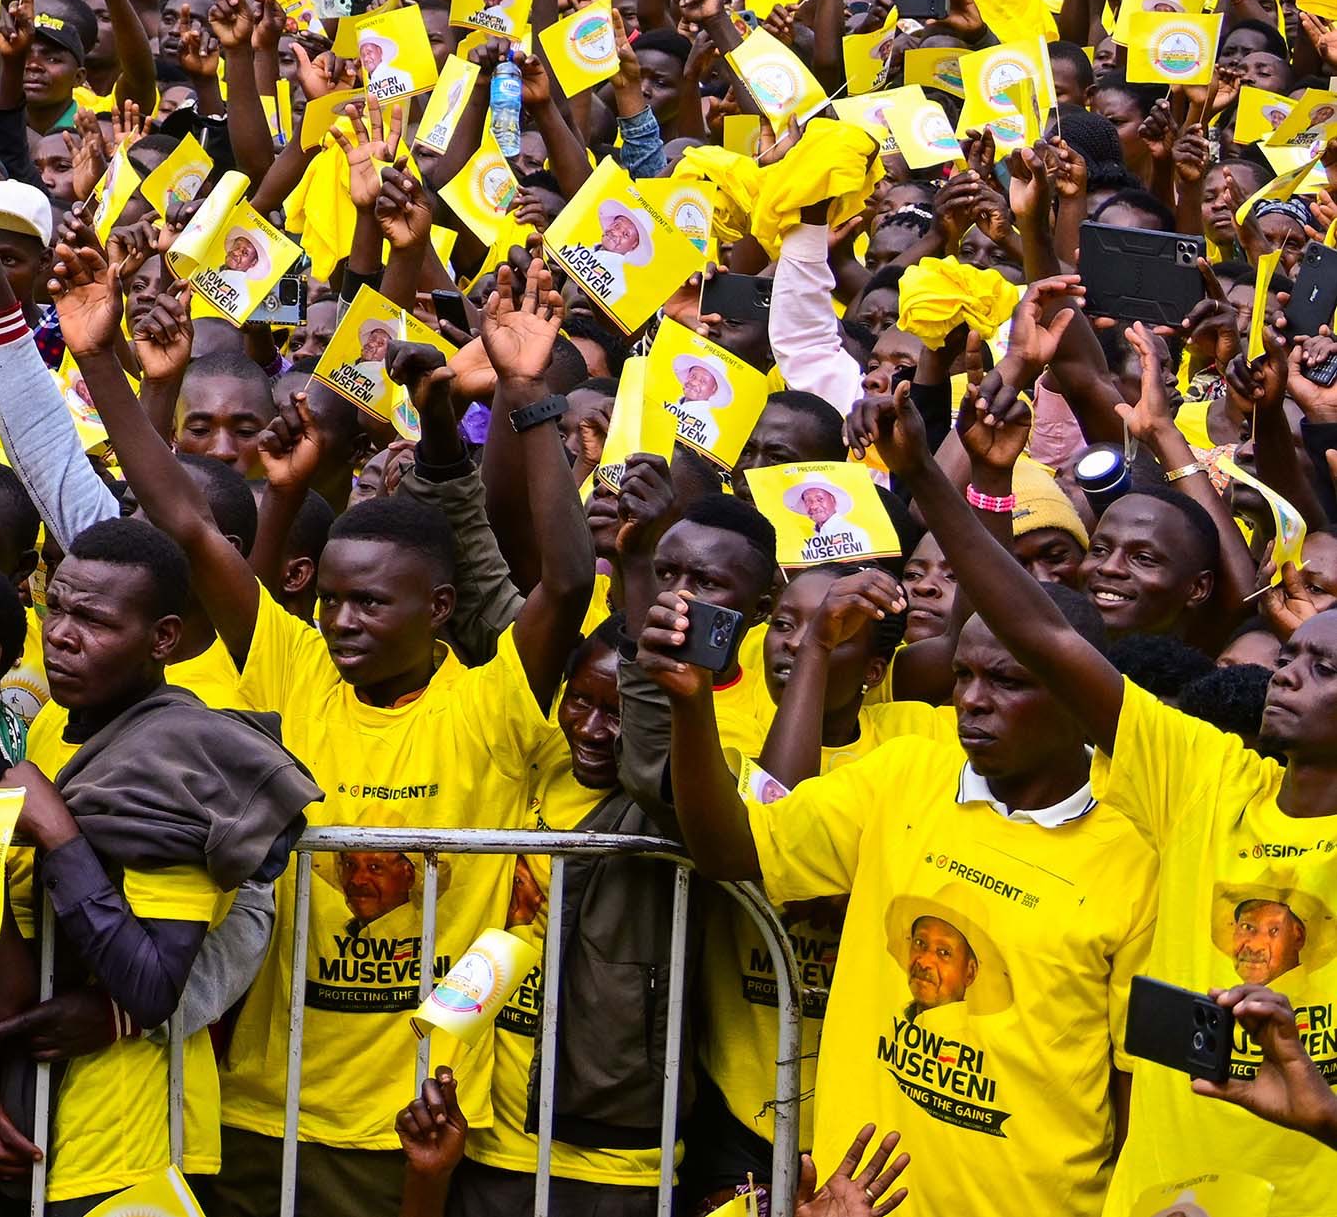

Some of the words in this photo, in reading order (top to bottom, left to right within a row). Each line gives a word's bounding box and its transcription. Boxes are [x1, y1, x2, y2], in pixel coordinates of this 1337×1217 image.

[367, 75, 398, 92] OWERI
[559, 244, 612, 300] MUSEVENI
[573, 241, 615, 287] YOWERI
[194, 272, 238, 314] MUSEVENI
[328, 368, 373, 403] MUSEVENI
[800, 542, 863, 561] MUSEVENI
[804, 532, 854, 549] YOWERI
[362, 785, 427, 800] PRESIDENT
[948, 860, 1023, 901] PRESIDENT
[318, 988, 389, 1001] PROTECTING
[392, 990, 414, 1001] THE
[893, 1016, 984, 1074] YOWERI
[877, 1035, 996, 1103] MUSEVENI
[932, 1095, 953, 1112] THE
[954, 1103, 993, 1124] GAINS
